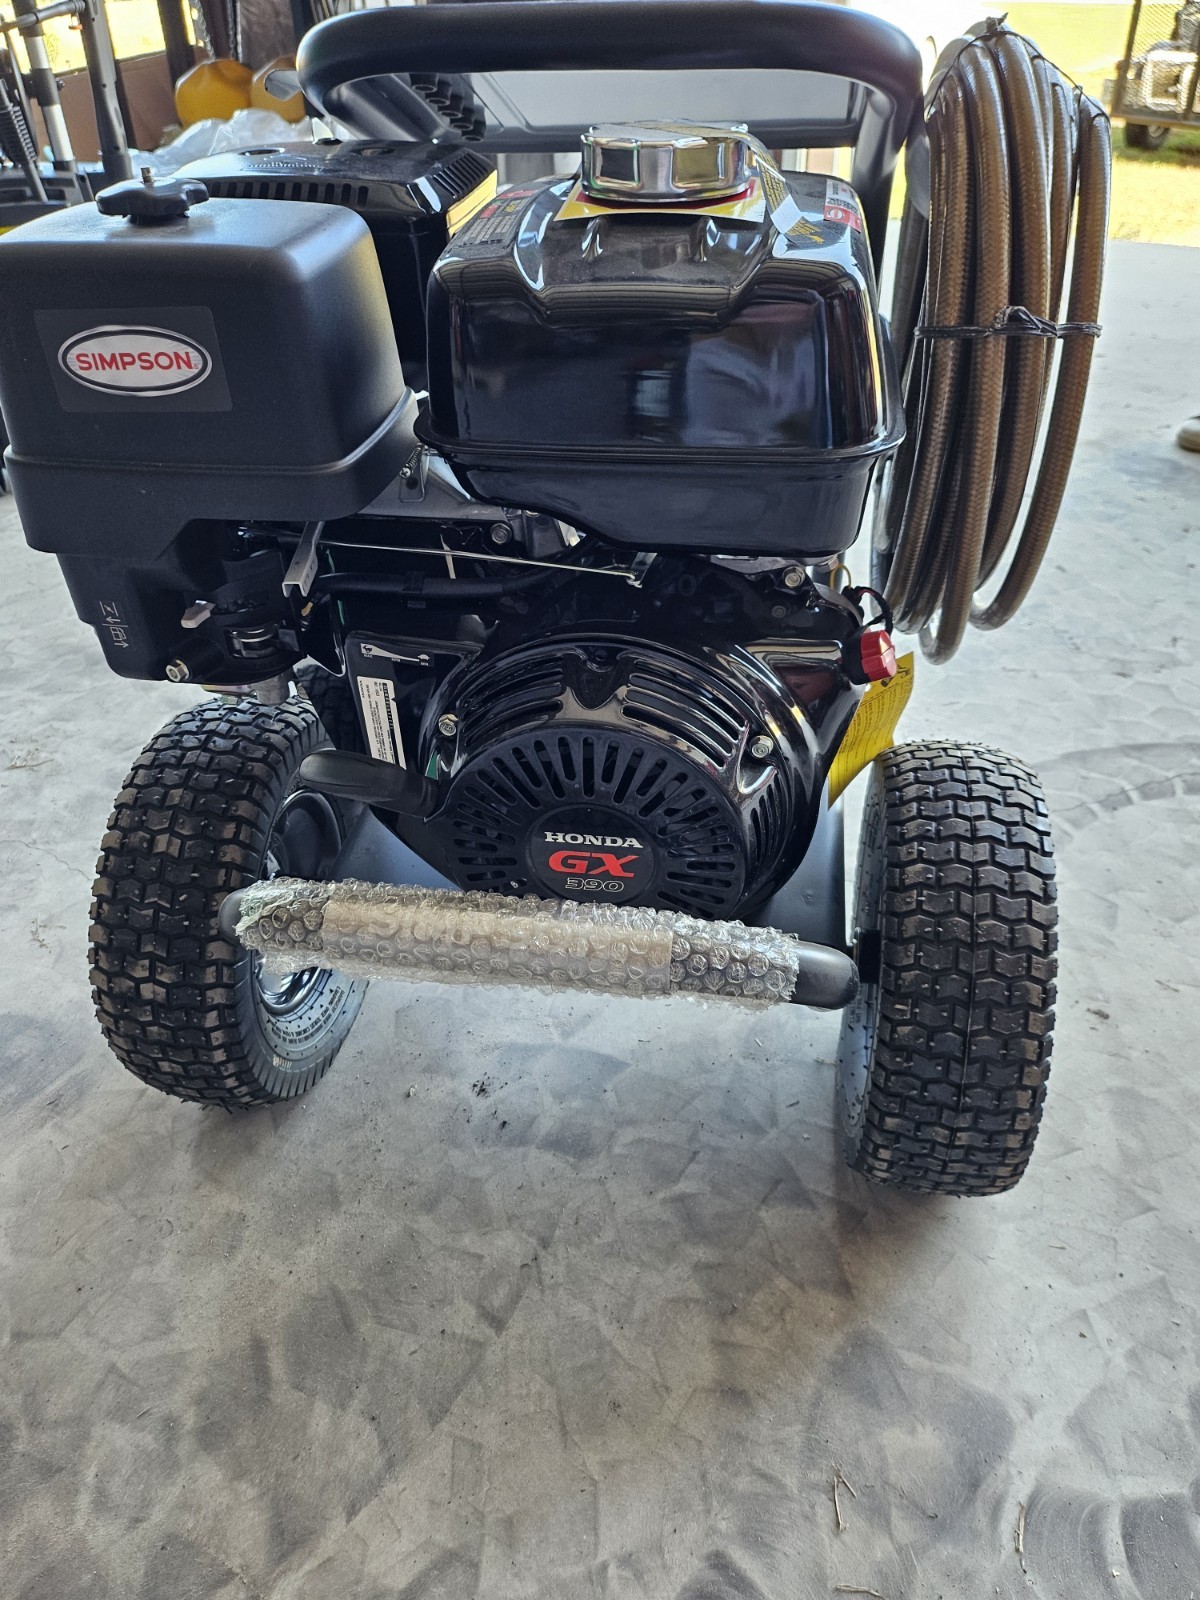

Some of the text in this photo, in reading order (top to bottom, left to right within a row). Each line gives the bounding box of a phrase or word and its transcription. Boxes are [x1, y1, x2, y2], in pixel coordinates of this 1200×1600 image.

[75, 351, 193, 371] SIMPSON
[544, 831, 643, 848] HONDA
[548, 850, 640, 878] GX
[565, 877, 625, 893] 390
